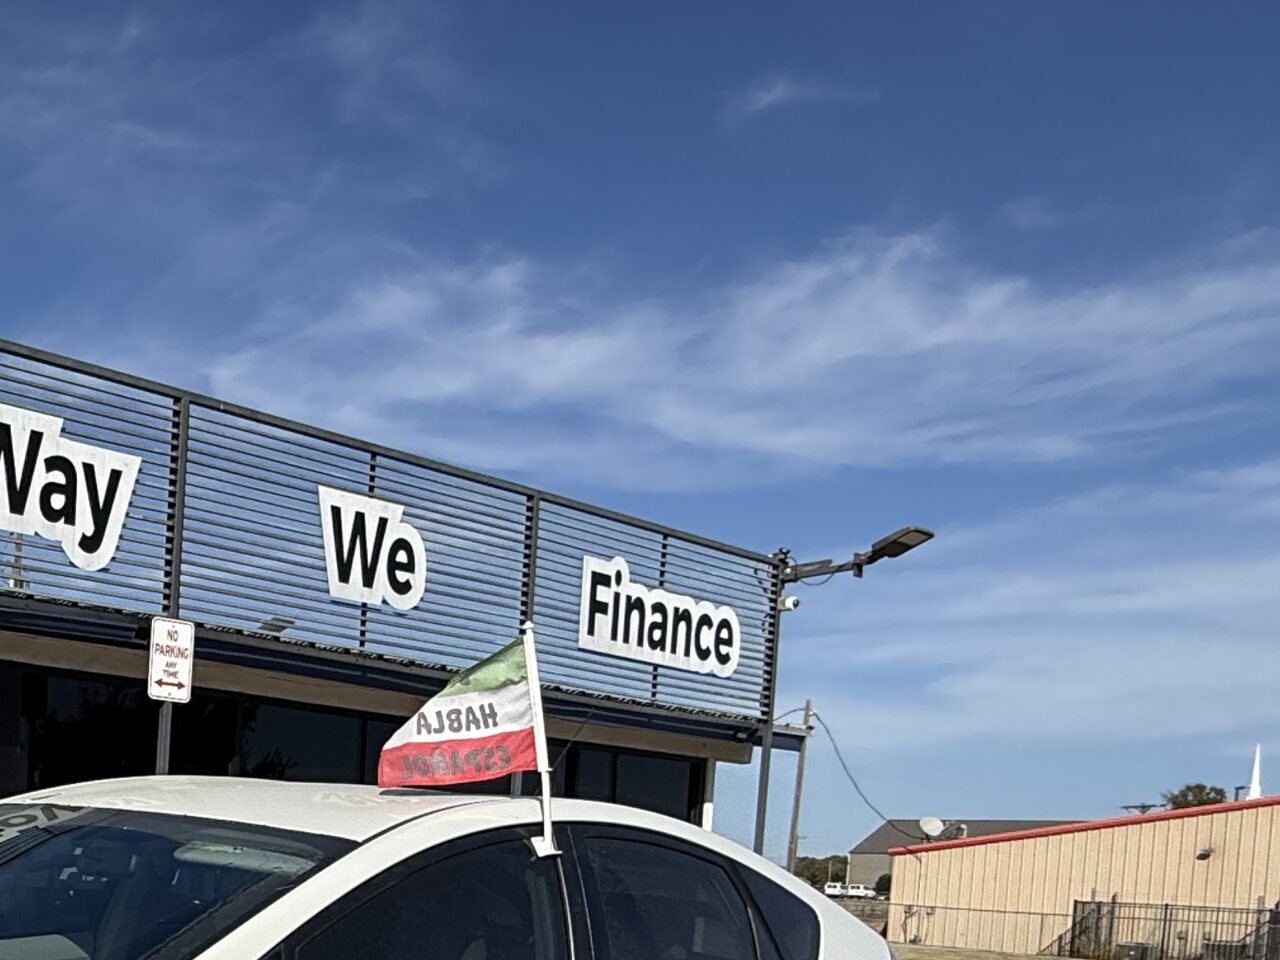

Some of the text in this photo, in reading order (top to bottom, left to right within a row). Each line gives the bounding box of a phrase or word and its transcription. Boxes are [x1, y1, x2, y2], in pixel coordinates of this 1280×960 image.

[330, 504, 417, 596] We
[586, 568, 735, 667] Finance
[167, 629, 178, 641] NO
[154, 643, 189, 659] PARKING
[163, 669, 179, 679] TIME
